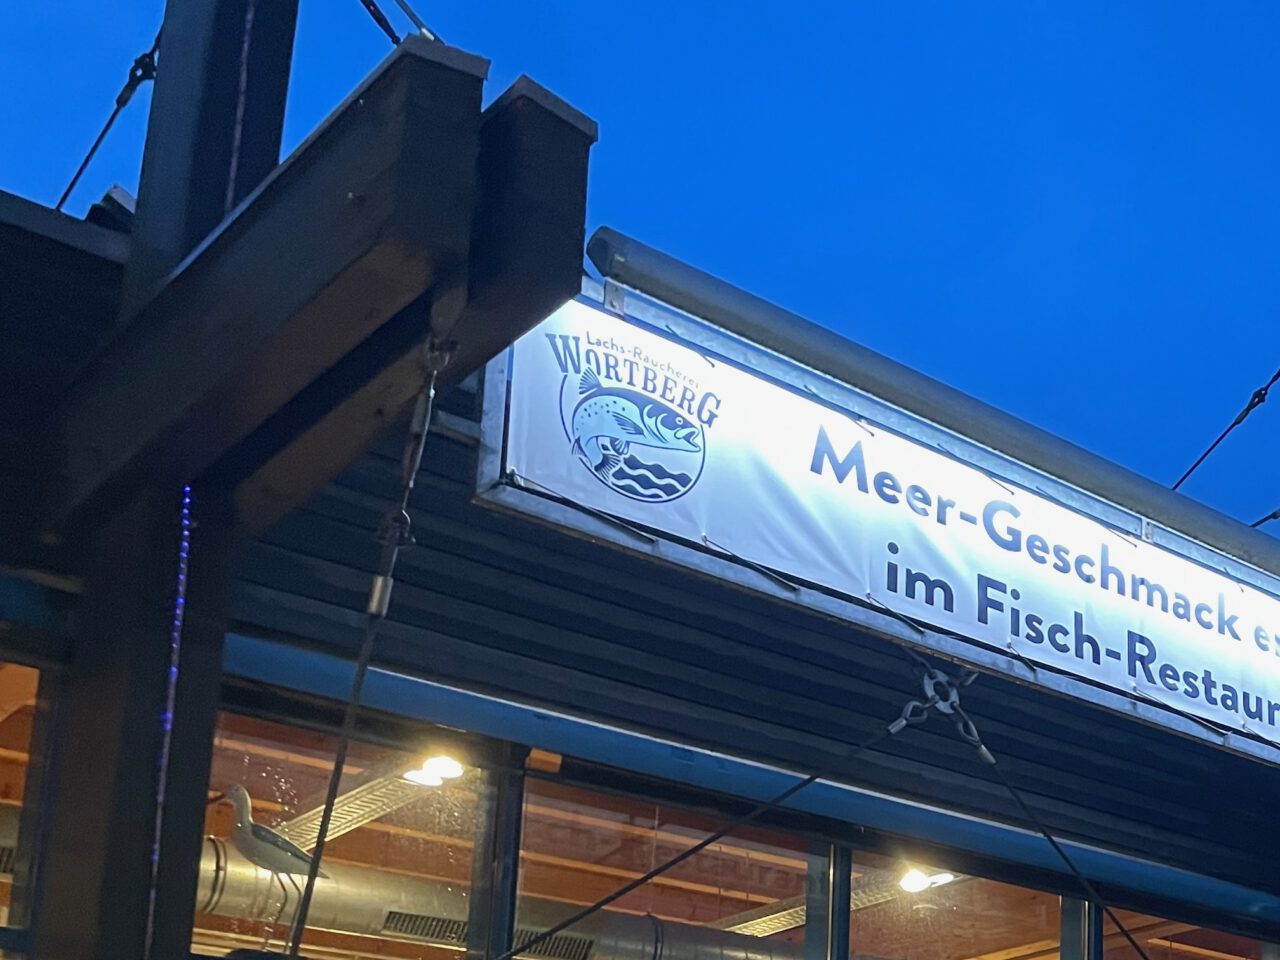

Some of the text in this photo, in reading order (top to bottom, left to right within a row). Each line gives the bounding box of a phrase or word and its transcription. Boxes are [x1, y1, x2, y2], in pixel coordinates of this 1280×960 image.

[545, 332, 722, 429] WORTBERG
[809, 423, 1242, 642] Meer-Geschmack
[886, 543, 954, 613] im
